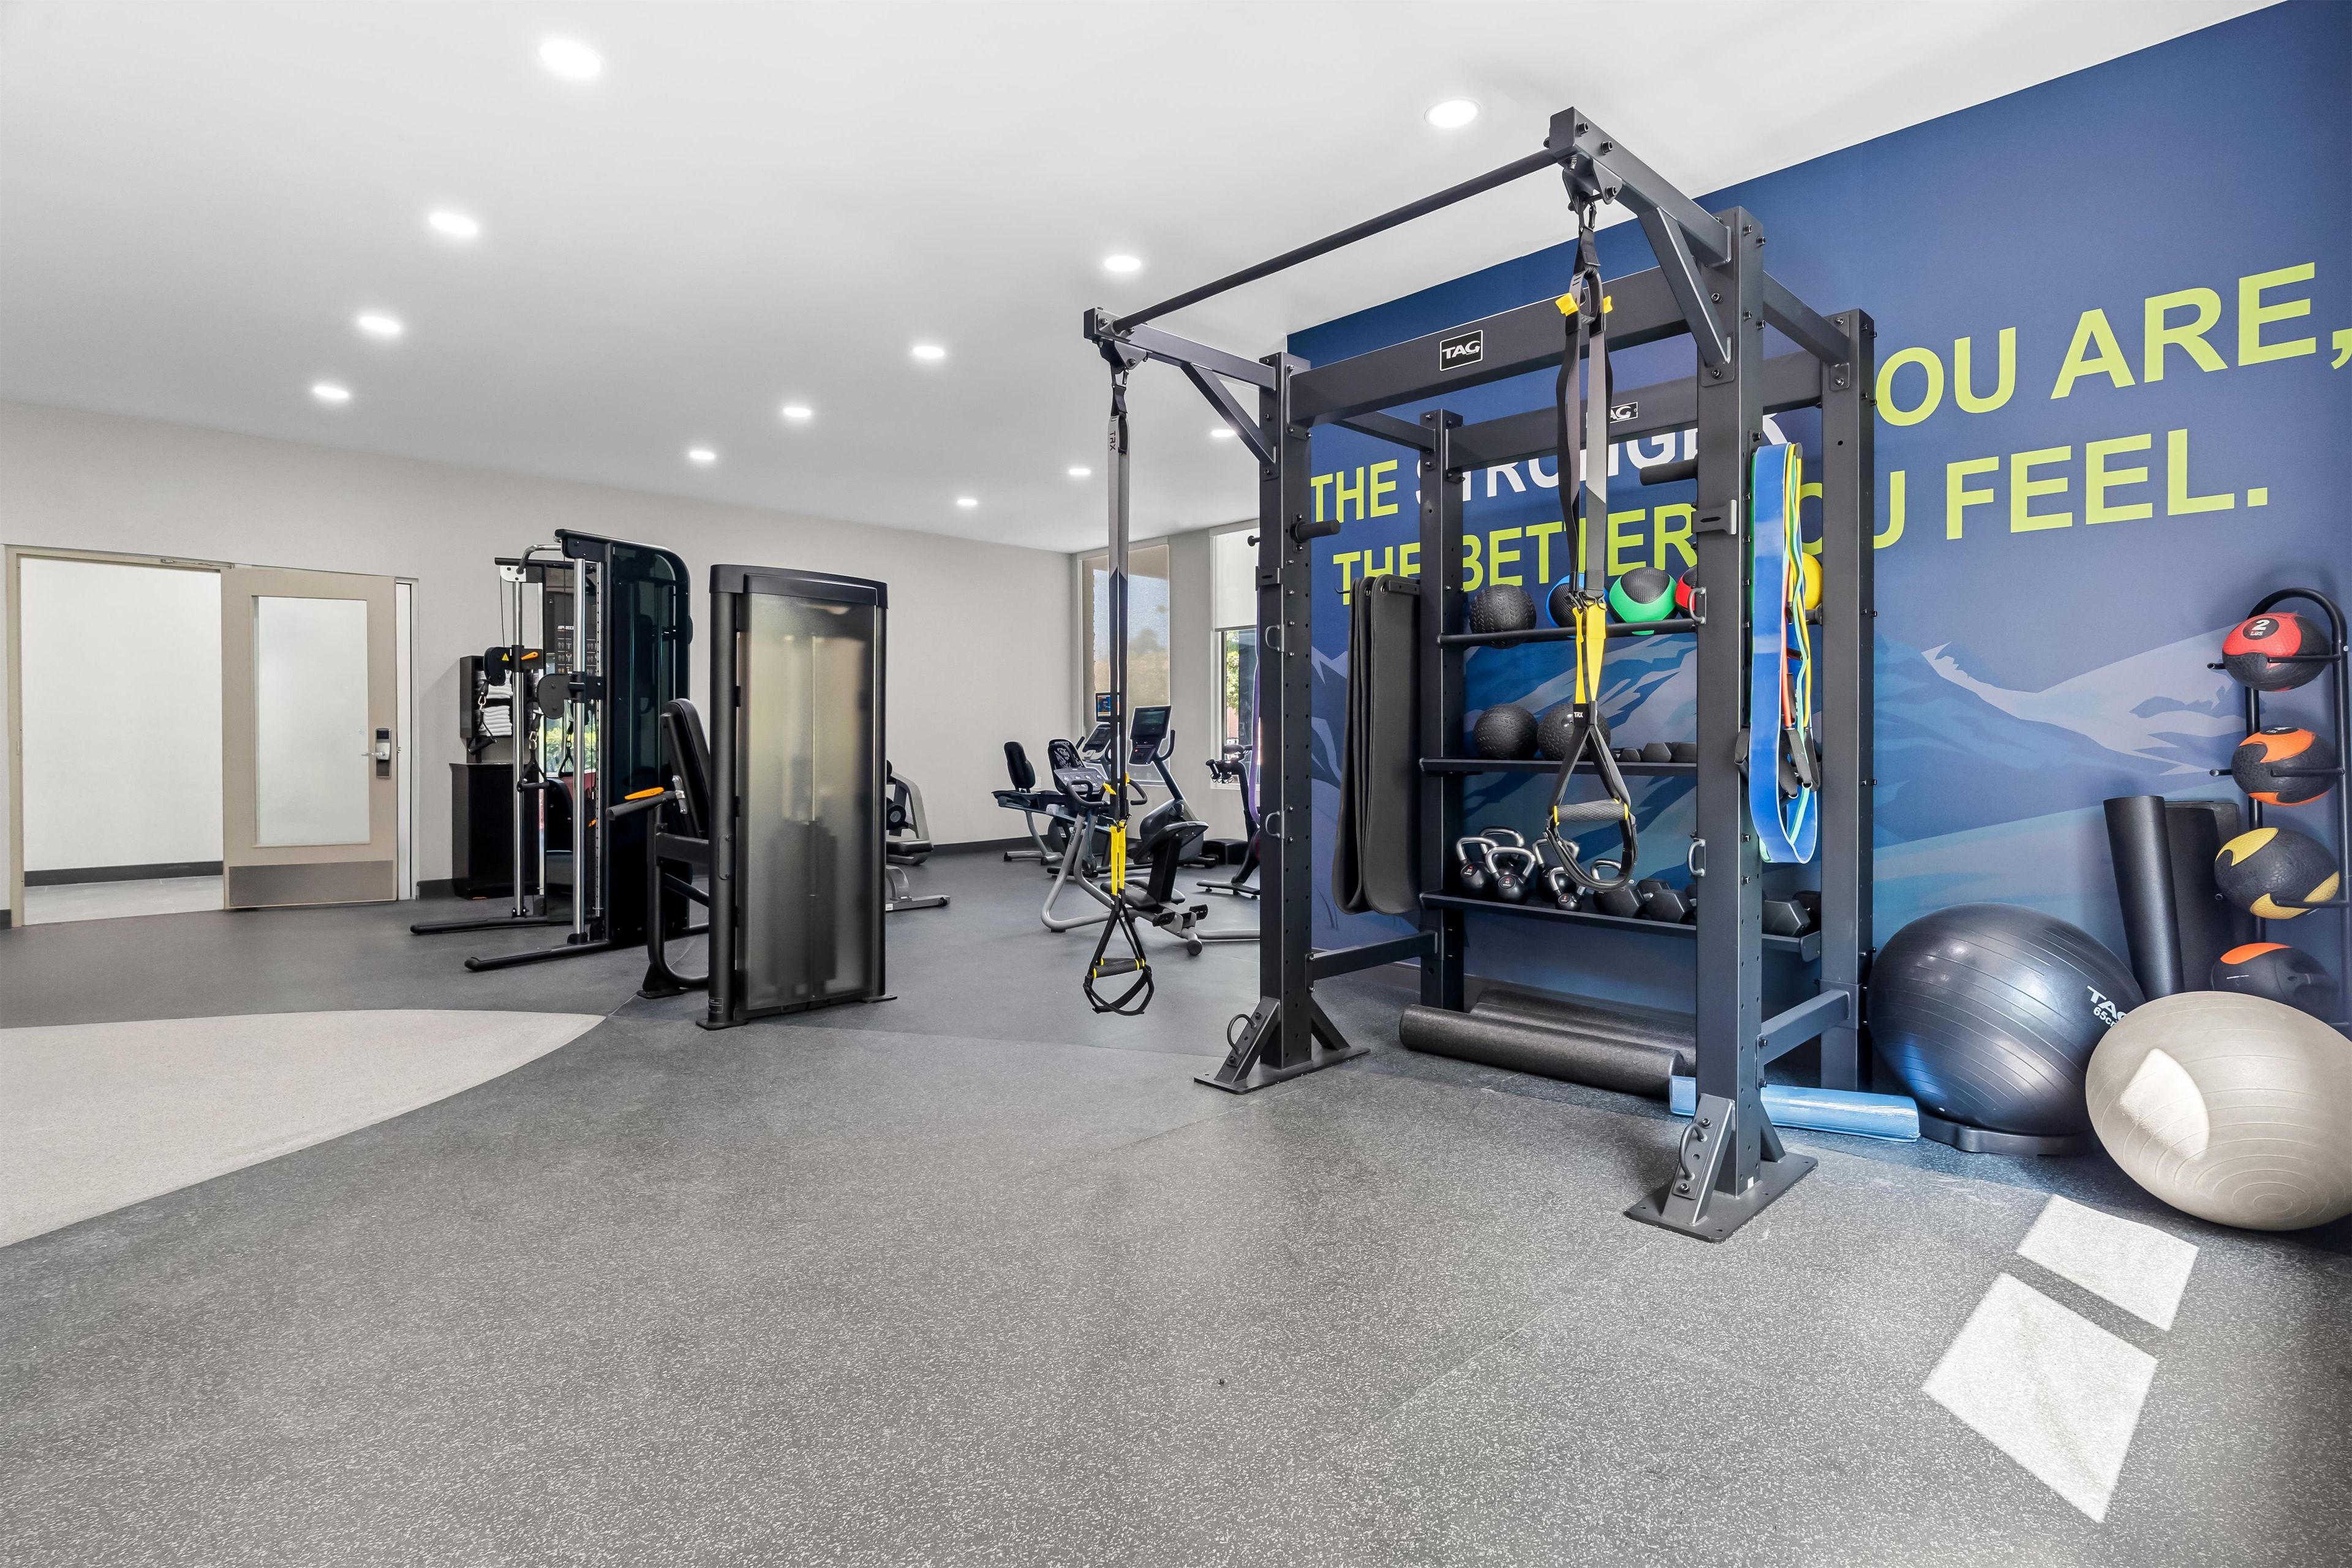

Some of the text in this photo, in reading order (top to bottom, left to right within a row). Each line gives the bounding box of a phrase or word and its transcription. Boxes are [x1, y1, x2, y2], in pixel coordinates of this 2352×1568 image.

[1442, 340, 1480, 360] TAG
[1311, 459, 1398, 523] THE
[1875, 326, 2016, 426] OU
[1946, 428, 2268, 540] FEEL.
[2252, 619, 2270, 631] 2
